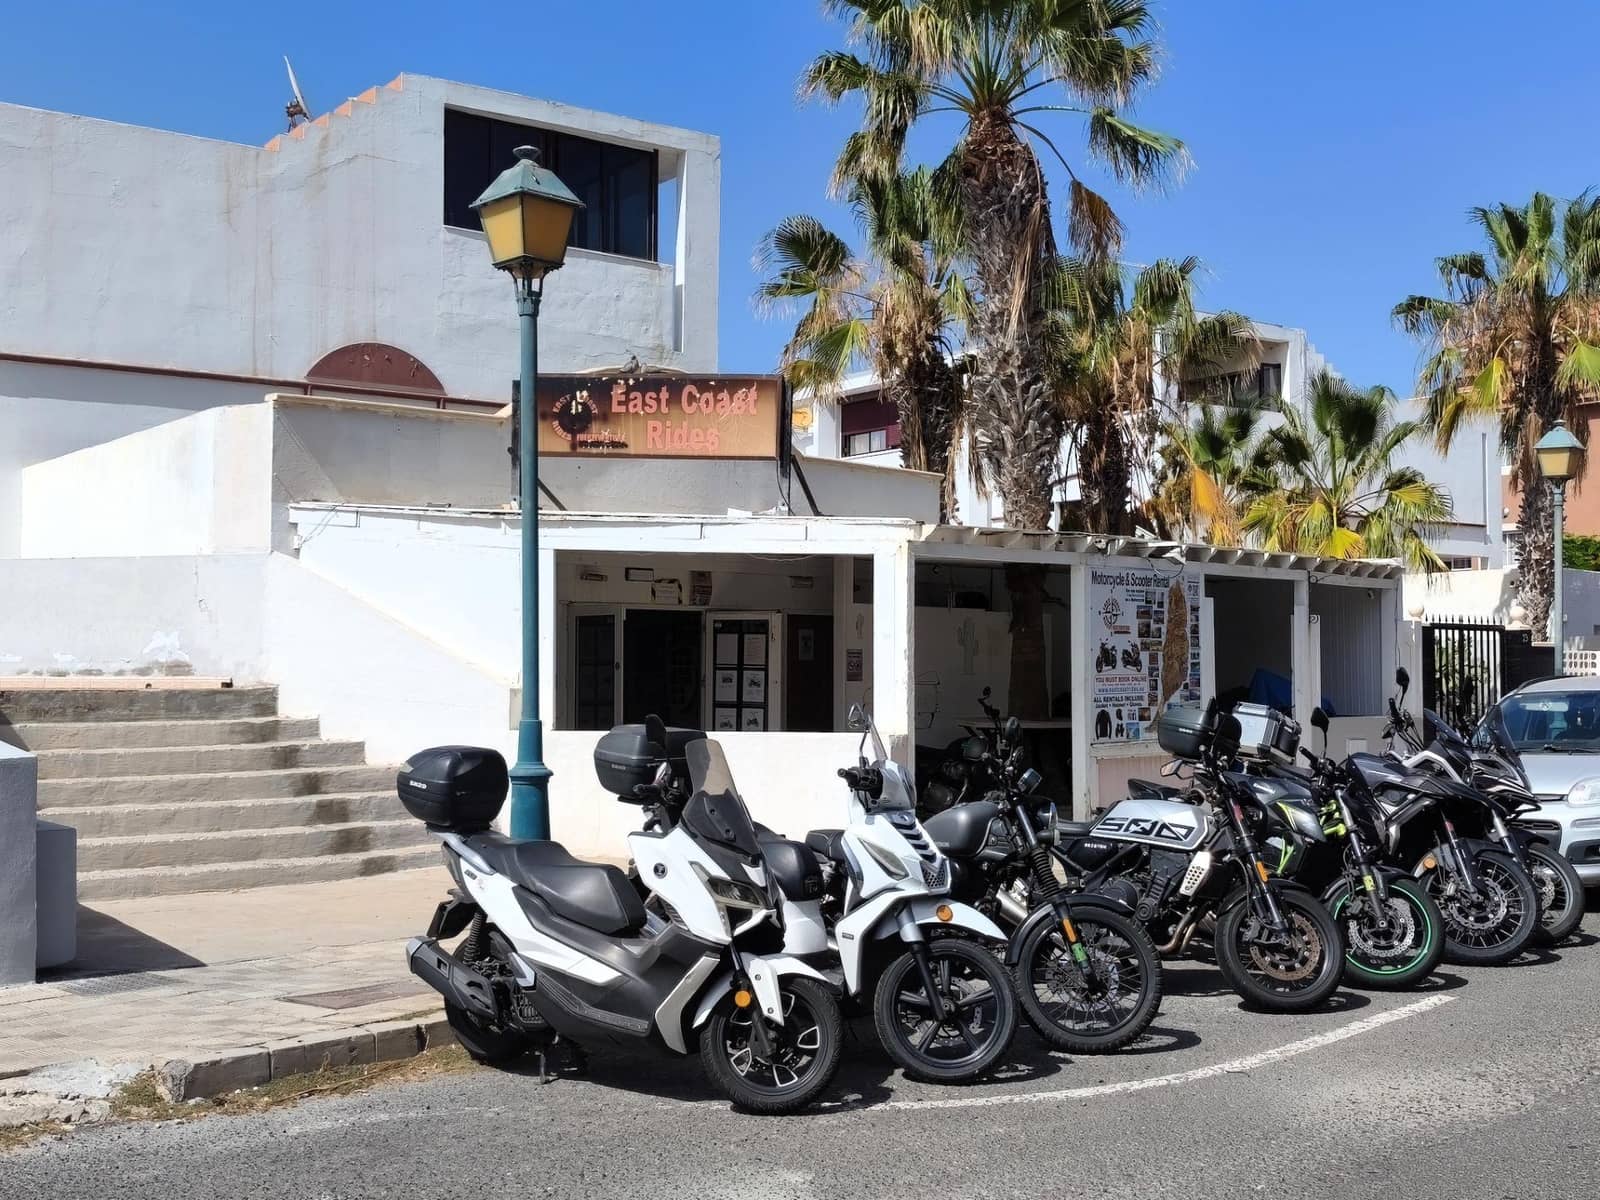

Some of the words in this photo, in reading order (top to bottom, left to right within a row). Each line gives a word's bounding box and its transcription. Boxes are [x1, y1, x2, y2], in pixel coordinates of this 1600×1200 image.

[611, 384, 669, 414] East
[681, 382, 758, 415] Coast
[647, 419, 720, 449] Rides
[1091, 570, 1124, 589] Motorcycle
[1125, 572, 1130, 586] &
[1130, 572, 1152, 587] Scooter
[1153, 574, 1170, 588] Rental
